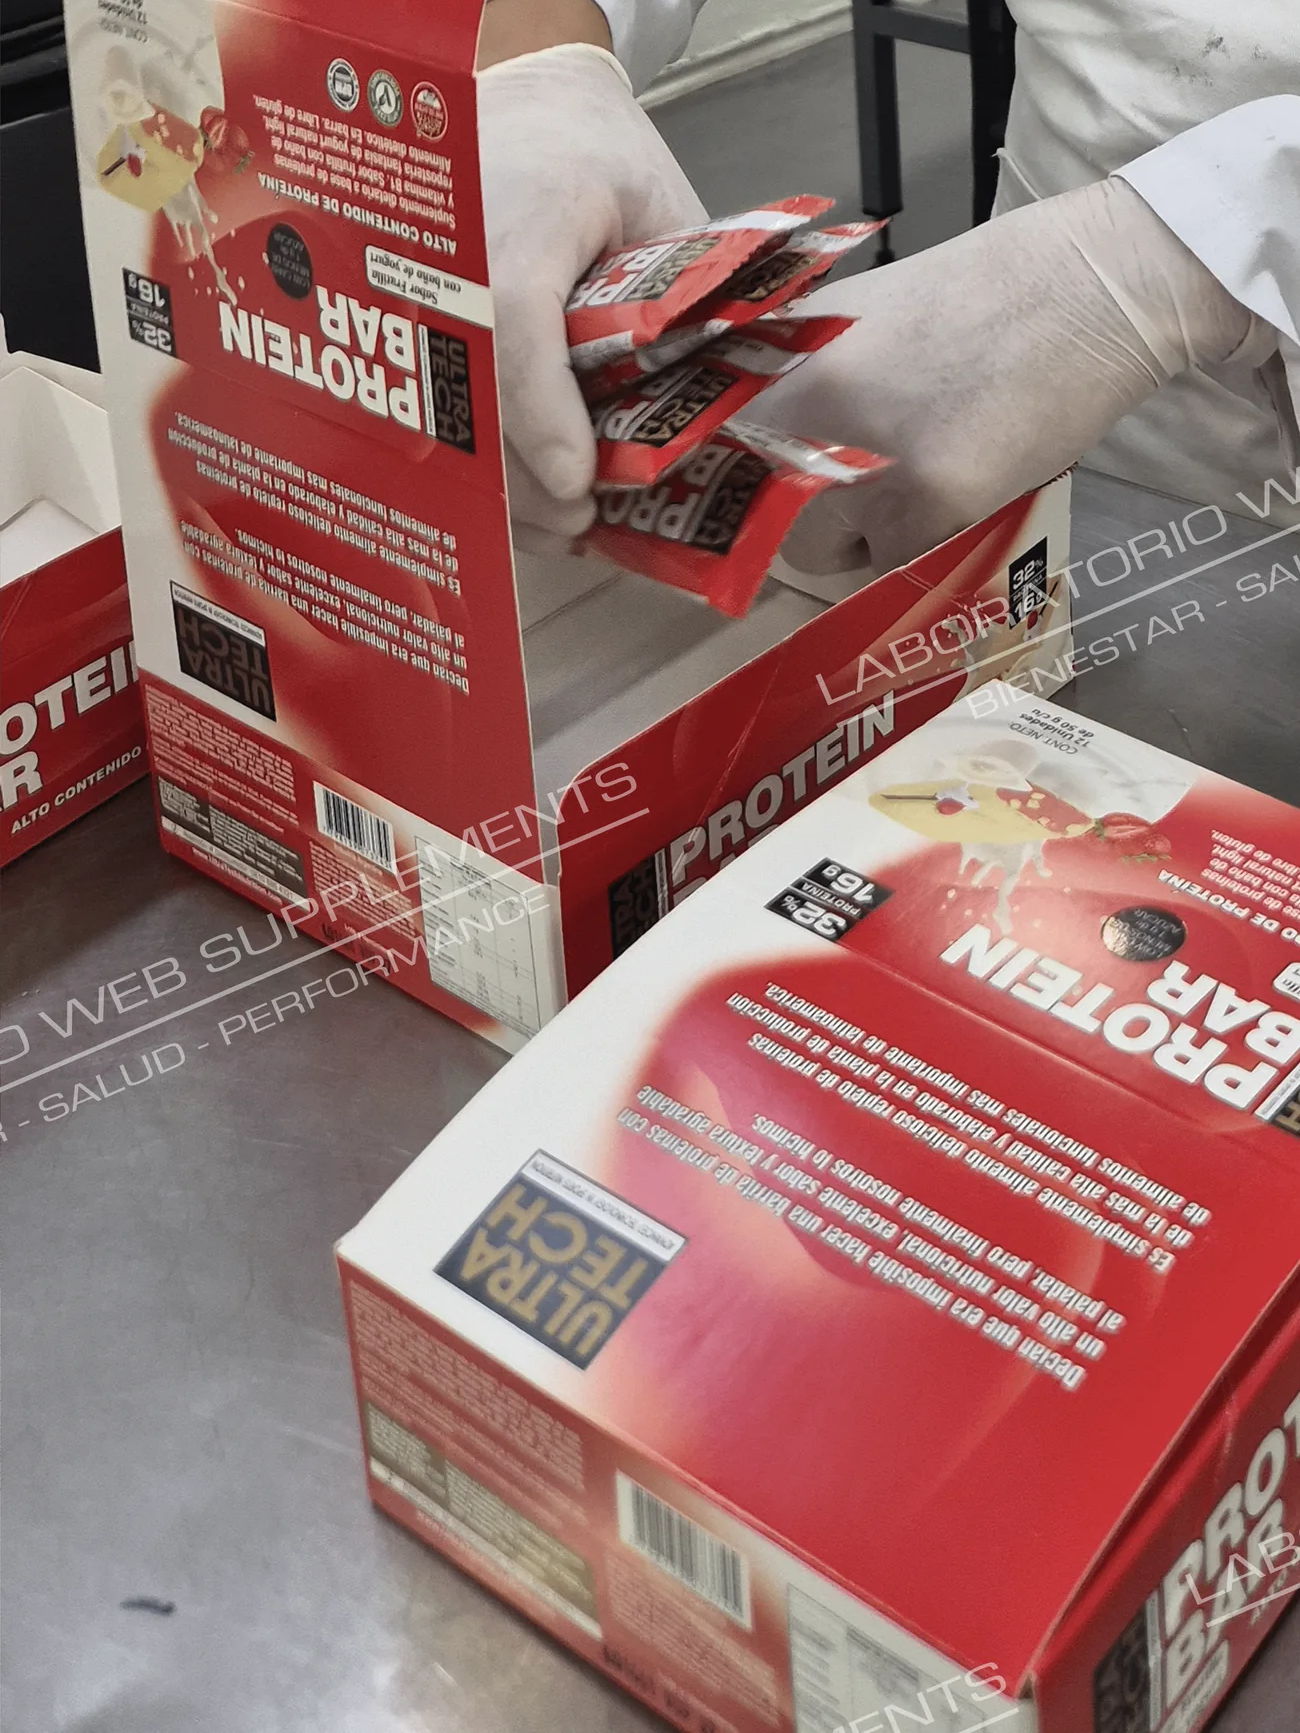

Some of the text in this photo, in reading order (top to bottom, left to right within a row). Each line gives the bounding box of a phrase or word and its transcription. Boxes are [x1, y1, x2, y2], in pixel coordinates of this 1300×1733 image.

[322, 194, 338, 213] DE
[343, 201, 418, 241] CONTENIDO
[423, 229, 455, 255] ALTO
[316, 284, 415, 371] BAR
[219, 300, 419, 431] PROTEIN
[177, 610, 265, 672] TECH
[0, 639, 137, 754] OTEI
[187, 647, 274, 716] ULTRA
[1016, 711, 1091, 747] 12 Unidades
[1050, 715, 1063, 724] g
[1059, 720, 1078, 732] 50
[1075, 727, 1095, 739] de
[11, 802, 50, 834] ALTO
[54, 746, 143, 807] CONTENIDO
[672, 689, 897, 881] PROTEIN
[769, 892, 848, 937] 32%
[1246, 911, 1283, 932] DE
[940, 922, 1278, 1107] PROTEIN
[803, 1033, 831, 1054] de
[824, 1042, 880, 1079] planta
[859, 1034, 888, 1054] de
[811, 1067, 841, 1089] de
[871, 1069, 896, 1088] la
[879, 1043, 972, 1100] importante
[889, 1078, 918, 1099] en
[632, 1081, 714, 1137] agradable
[834, 1078, 897, 1118] repleto
[911, 1090, 997, 1144] elaborado
[613, 1105, 651, 1132] con
[743, 1111, 816, 1160] hicimos.
[887, 1107, 968, 1159] delicioso
[999, 1106, 1101, 1169] funcionales
[702, 1122, 766, 1166] textura
[807, 1148, 835, 1169] lo
[991, 1130, 1013, 1149] y
[708, 1161, 740, 1186] de
[758, 1152, 779, 1170] y
[770, 1160, 821, 1196] sabor
[961, 1147, 1041, 1199] alimento
[1003, 1139, 1072, 1184] calidad
[731, 1172, 793, 1217] barrita
[825, 1156, 903, 1209] nosotros
[1065, 1171, 1107, 1202] alta
[1093, 1155, 1185, 1213] alimentos
[784, 1203, 824, 1232] una
[812, 1183, 900, 1244] excelente
[894, 1193, 990, 1258] finalmente
[1034, 1183, 1152, 1258] simplemente
[1140, 1211, 1167, 1234] la
[1178, 1201, 1211, 1226] de
[486, 1182, 650, 1310] TECH
[816, 1222, 873, 1263] hacer
[1160, 1222, 1193, 1249] de
[864, 1246, 956, 1311] imposible
[983, 1242, 1032, 1279] pero
[1143, 1245, 1175, 1272] Es
[458, 1227, 614, 1358] ULTRA
[947, 1295, 986, 1326] era
[988, 1283, 1043, 1323] valor
[978, 1312, 1024, 1348] que
[1033, 1309, 1079, 1344] alto
[1096, 1308, 1125, 1333] al
[1072, 1330, 1106, 1359] un
[1167, 1499, 1285, 1709] BAR
